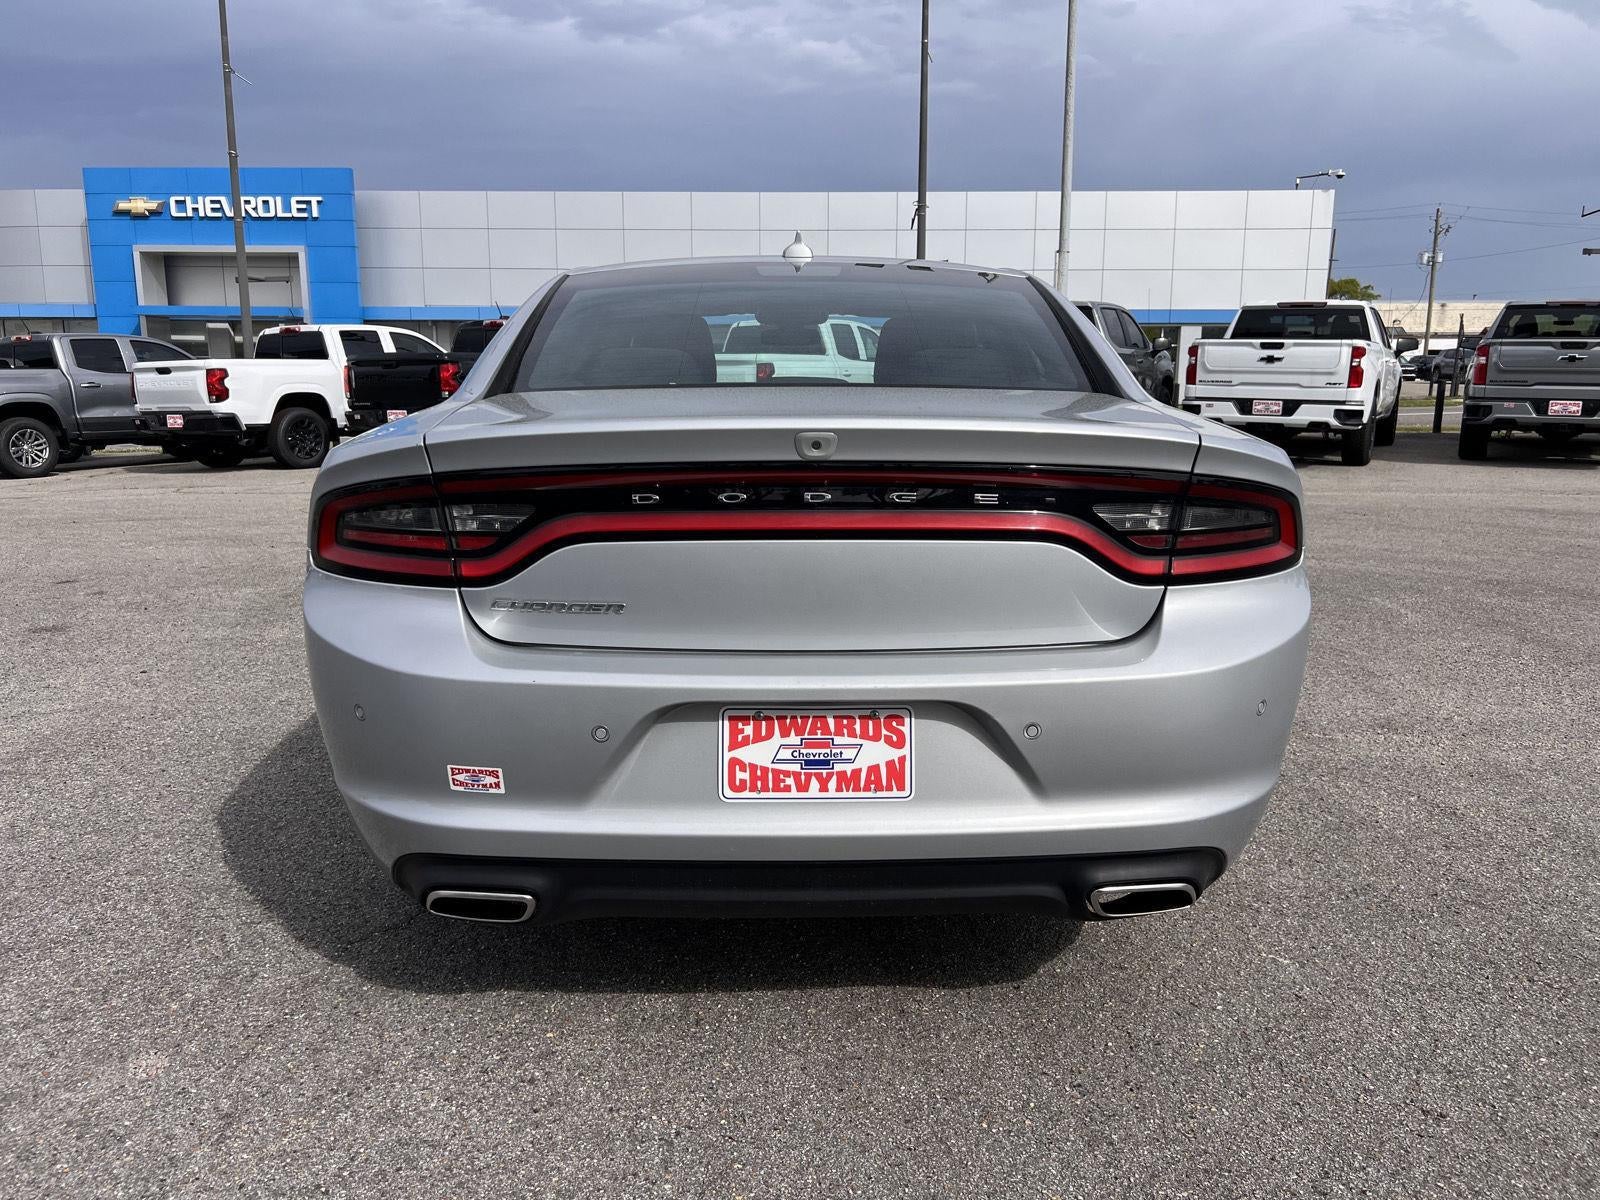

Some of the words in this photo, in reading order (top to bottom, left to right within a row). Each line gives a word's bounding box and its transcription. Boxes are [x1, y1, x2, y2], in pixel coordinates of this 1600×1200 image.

[169, 196, 322, 218] CHEVROLET
[632, 492, 999, 504] DODGE
[490, 600, 626, 615] CHARGER
[727, 714, 907, 753] EDWARDS
[790, 750, 844, 759] Chevrolet
[450, 767, 500, 780] EDWARDS
[727, 754, 907, 794] CHEVYMAN
[451, 777, 501, 790] CHEVYMAN
